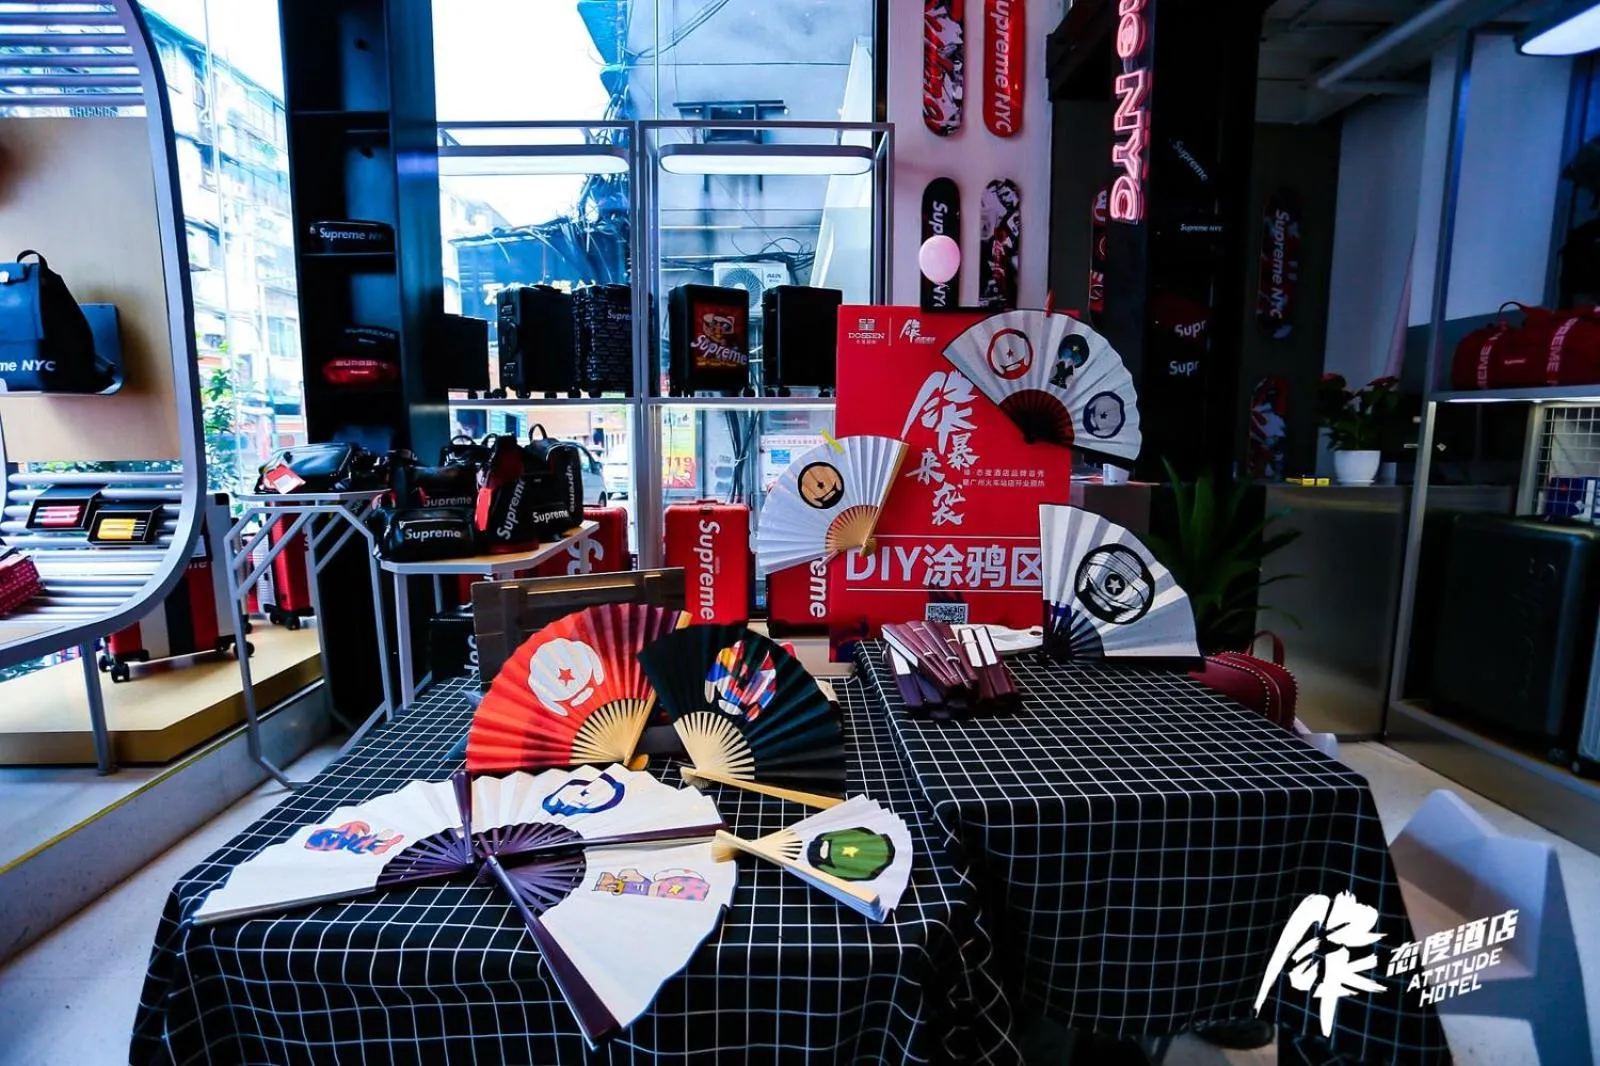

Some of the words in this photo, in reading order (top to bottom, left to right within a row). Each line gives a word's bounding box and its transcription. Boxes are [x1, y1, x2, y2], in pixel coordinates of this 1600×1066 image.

[990, 0, 1010, 89] upreme
[994, 92, 1012, 133] NYC
[1110, 69, 1144, 221] NYC
[1171, 139, 1209, 183] Supreme
[319, 226, 366, 242] Supreme
[929, 199, 949, 236] Sup
[1270, 208, 1291, 286] Supreme
[690, 333, 748, 366] Supreme
[848, 332, 885, 340] DOSSEN
[21, 359, 57, 372] NYC
[404, 527, 462, 543] Supreme
[532, 509, 570, 524] Supreme
[693, 519, 721, 621] Supreme
